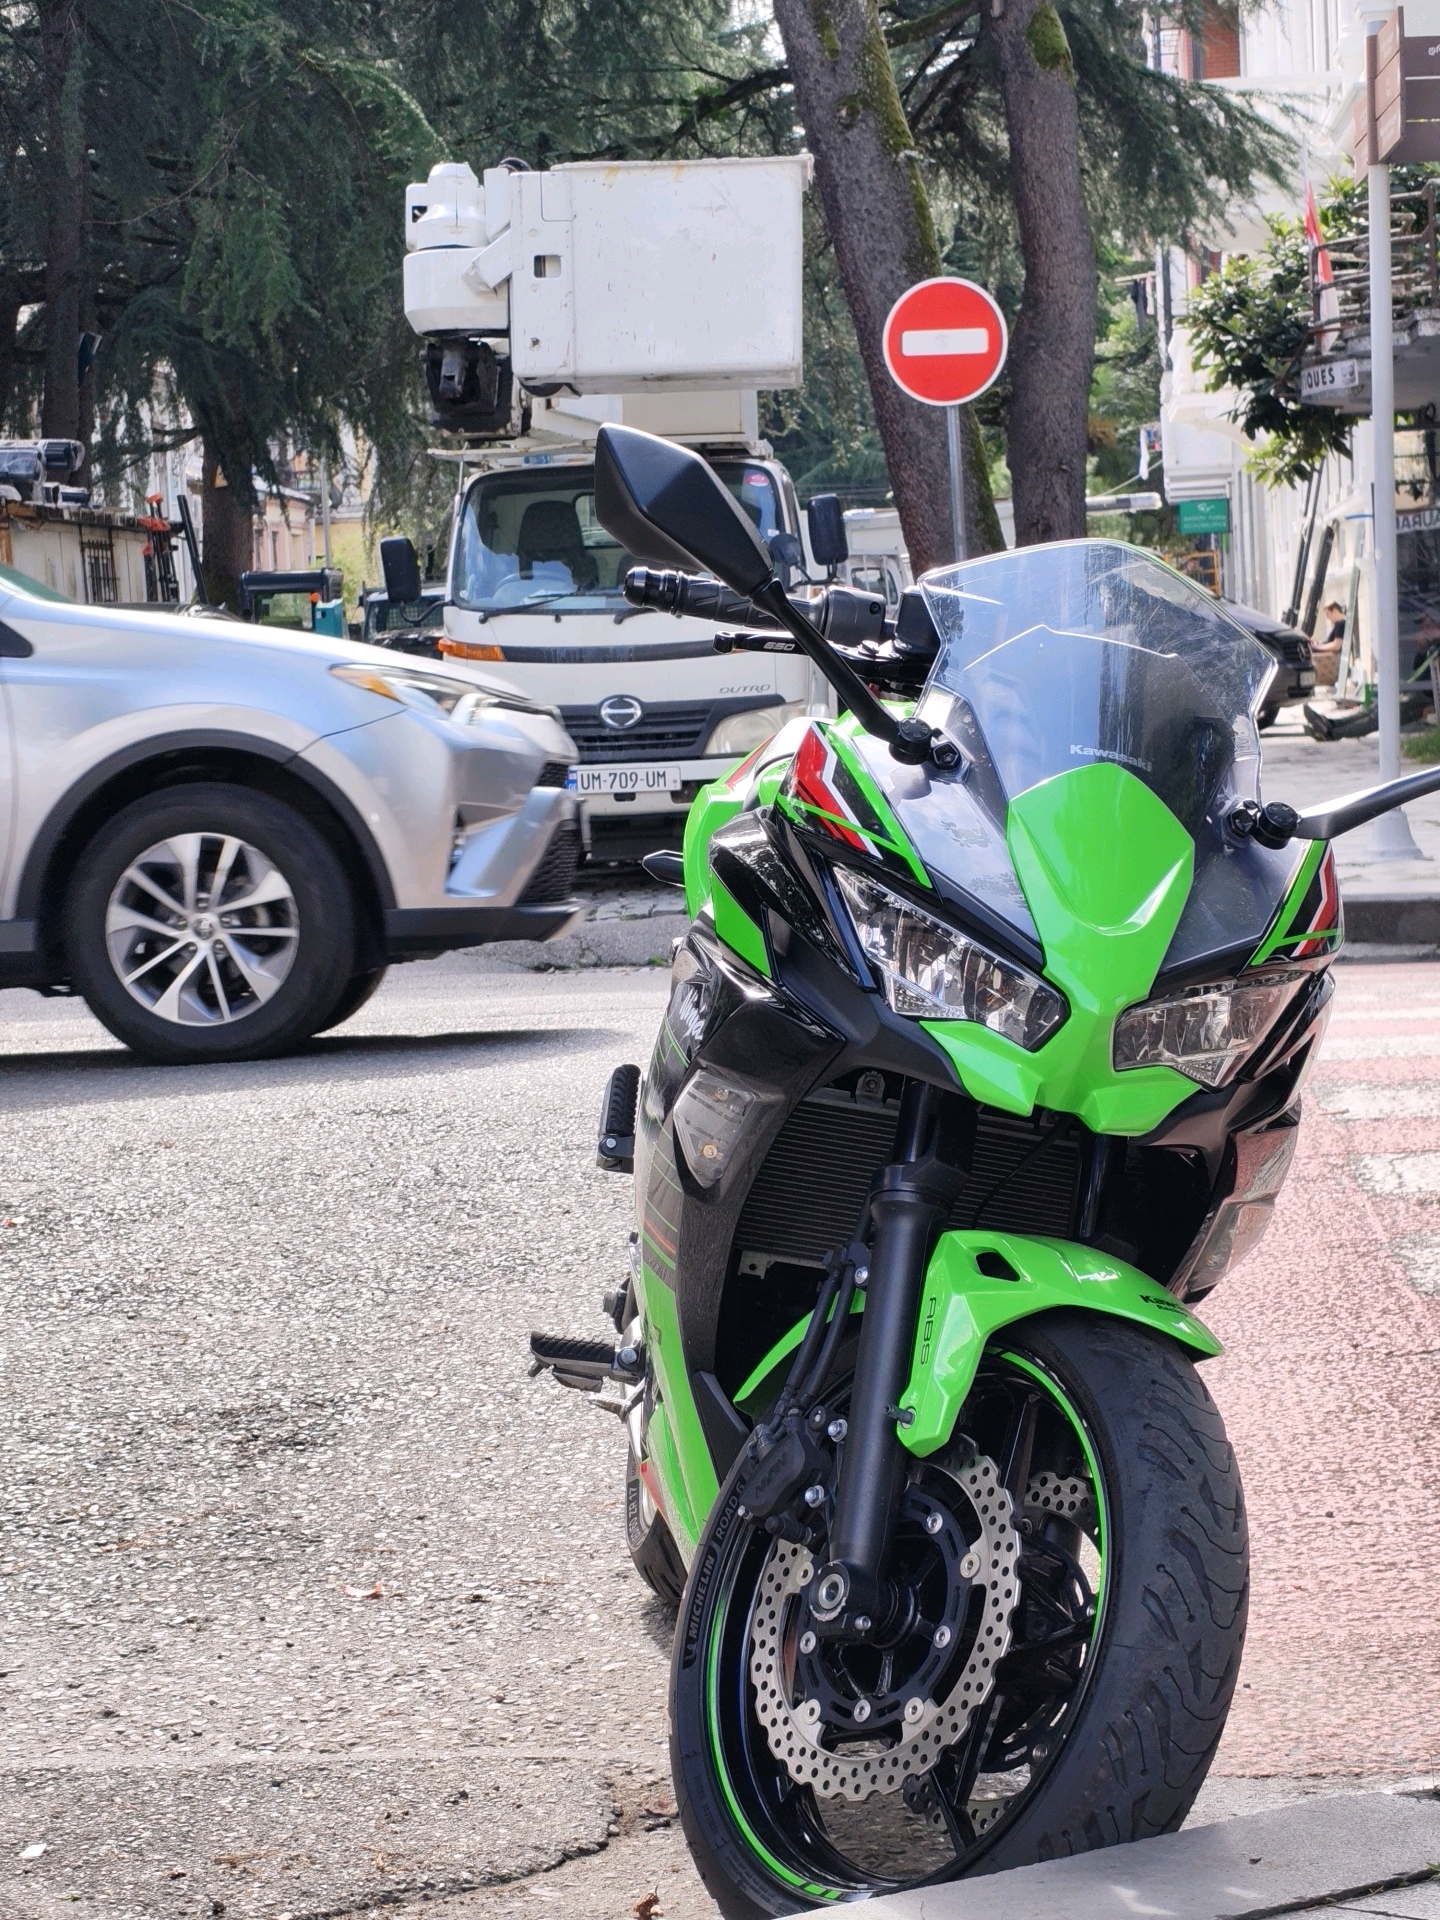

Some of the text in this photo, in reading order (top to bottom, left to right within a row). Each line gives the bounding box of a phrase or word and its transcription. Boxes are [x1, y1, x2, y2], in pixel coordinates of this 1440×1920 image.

[763, 642, 795, 651] 650
[719, 684, 771, 694] DUTRO
[1069, 744, 1152, 772] Kawasaki
[580, 770, 667, 790] UM-709-UM
[920, 1297, 937, 1365] ABS
[688, 1554, 715, 1639] MICHELIN
[715, 1495, 738, 1540] ROAD
